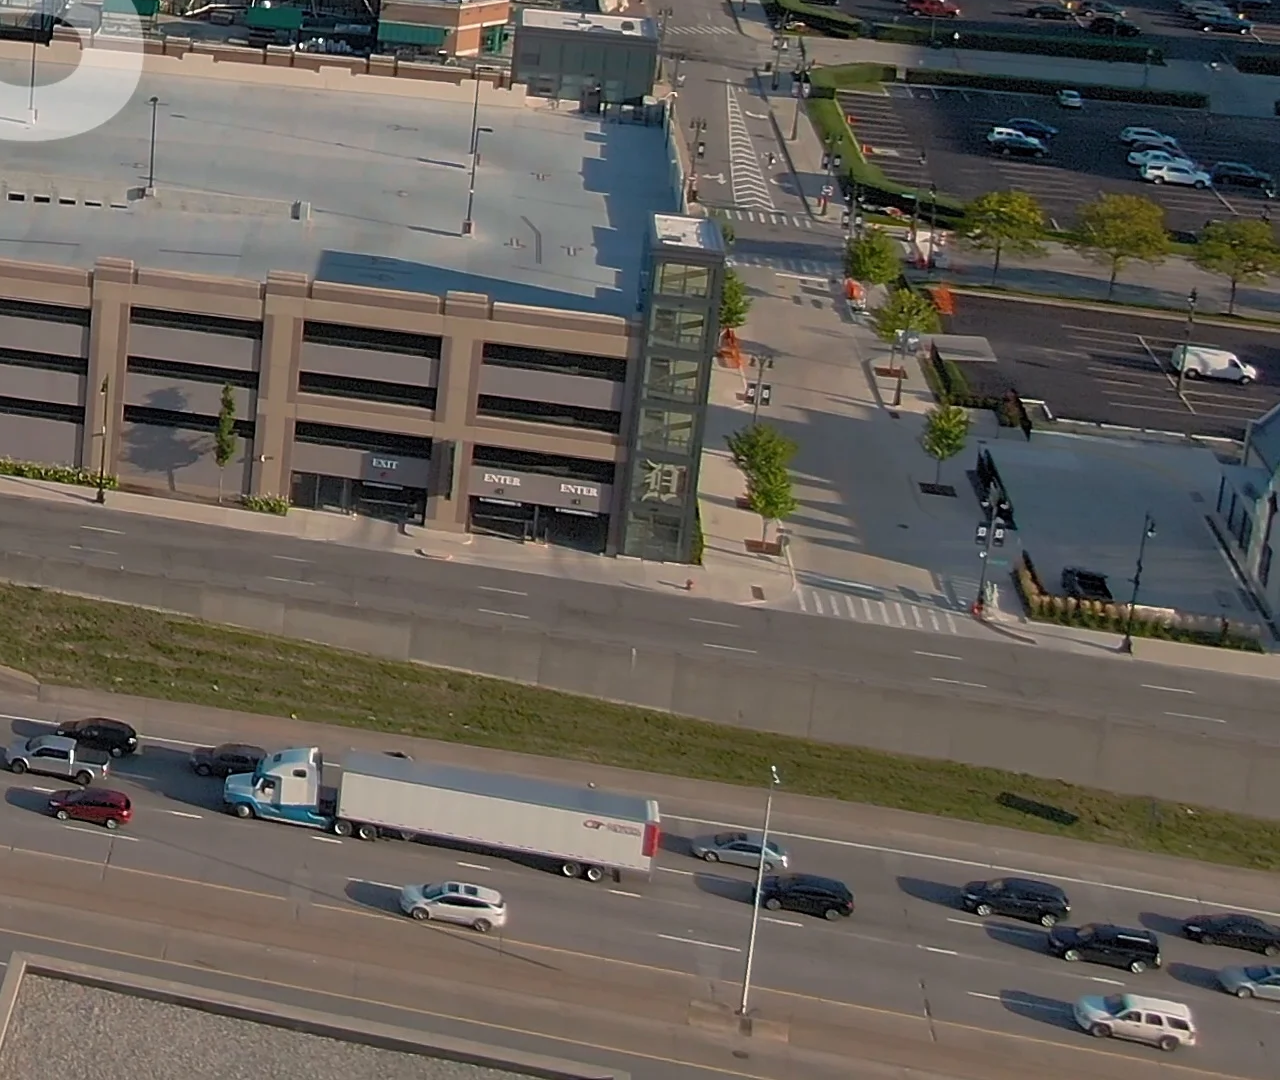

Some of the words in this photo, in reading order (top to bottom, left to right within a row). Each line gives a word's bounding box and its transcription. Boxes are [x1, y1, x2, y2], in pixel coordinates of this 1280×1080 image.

[372, 458, 398, 469] EXIT
[484, 473, 521, 487] ENTER
[560, 483, 598, 497] ENTER
